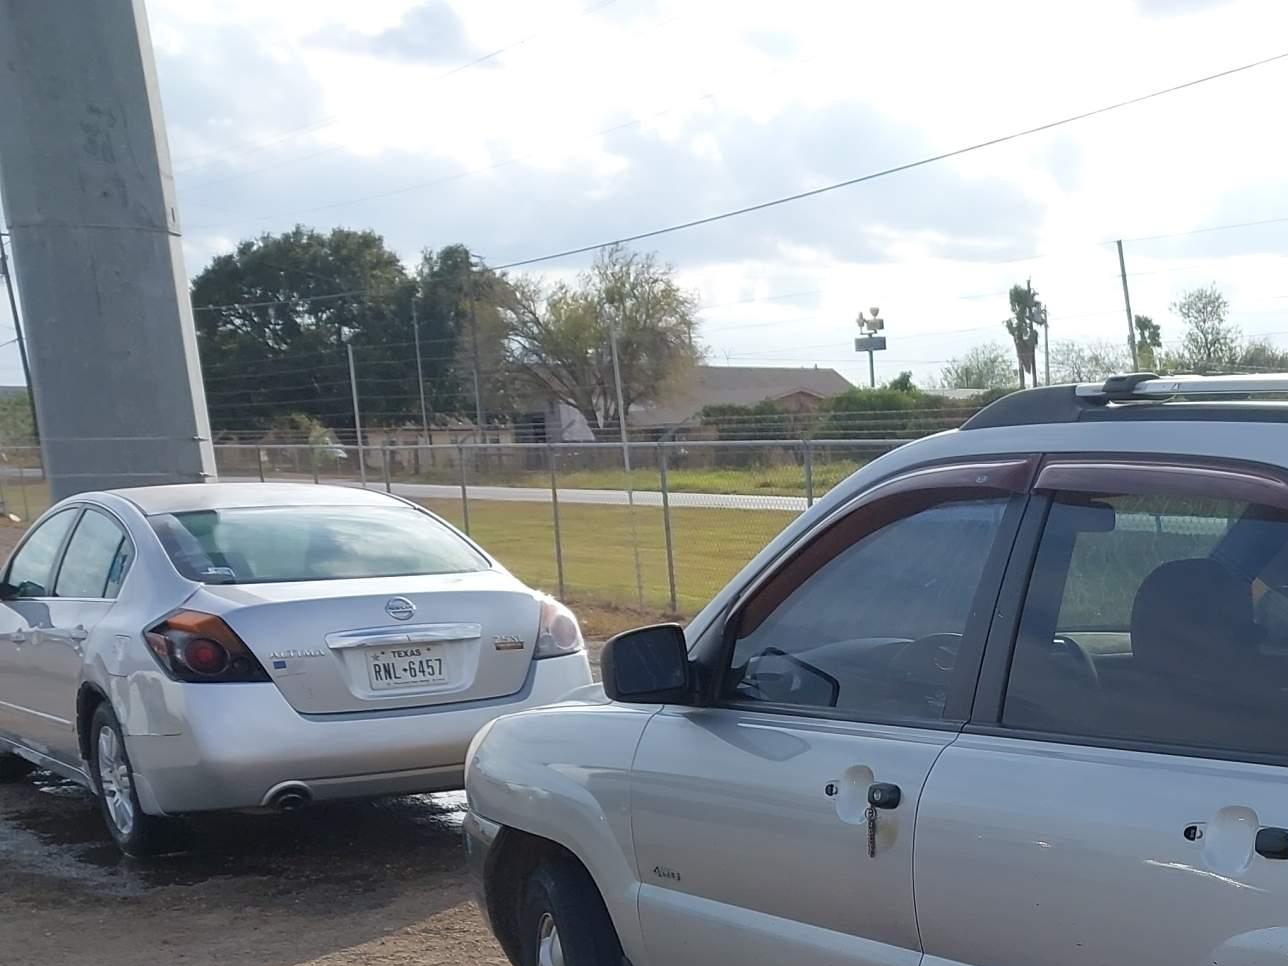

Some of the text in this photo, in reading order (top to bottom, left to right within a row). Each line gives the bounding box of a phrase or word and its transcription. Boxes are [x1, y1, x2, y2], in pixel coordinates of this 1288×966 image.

[391, 648, 422, 658] TEXAS
[373, 658, 443, 681] RNL 6457
